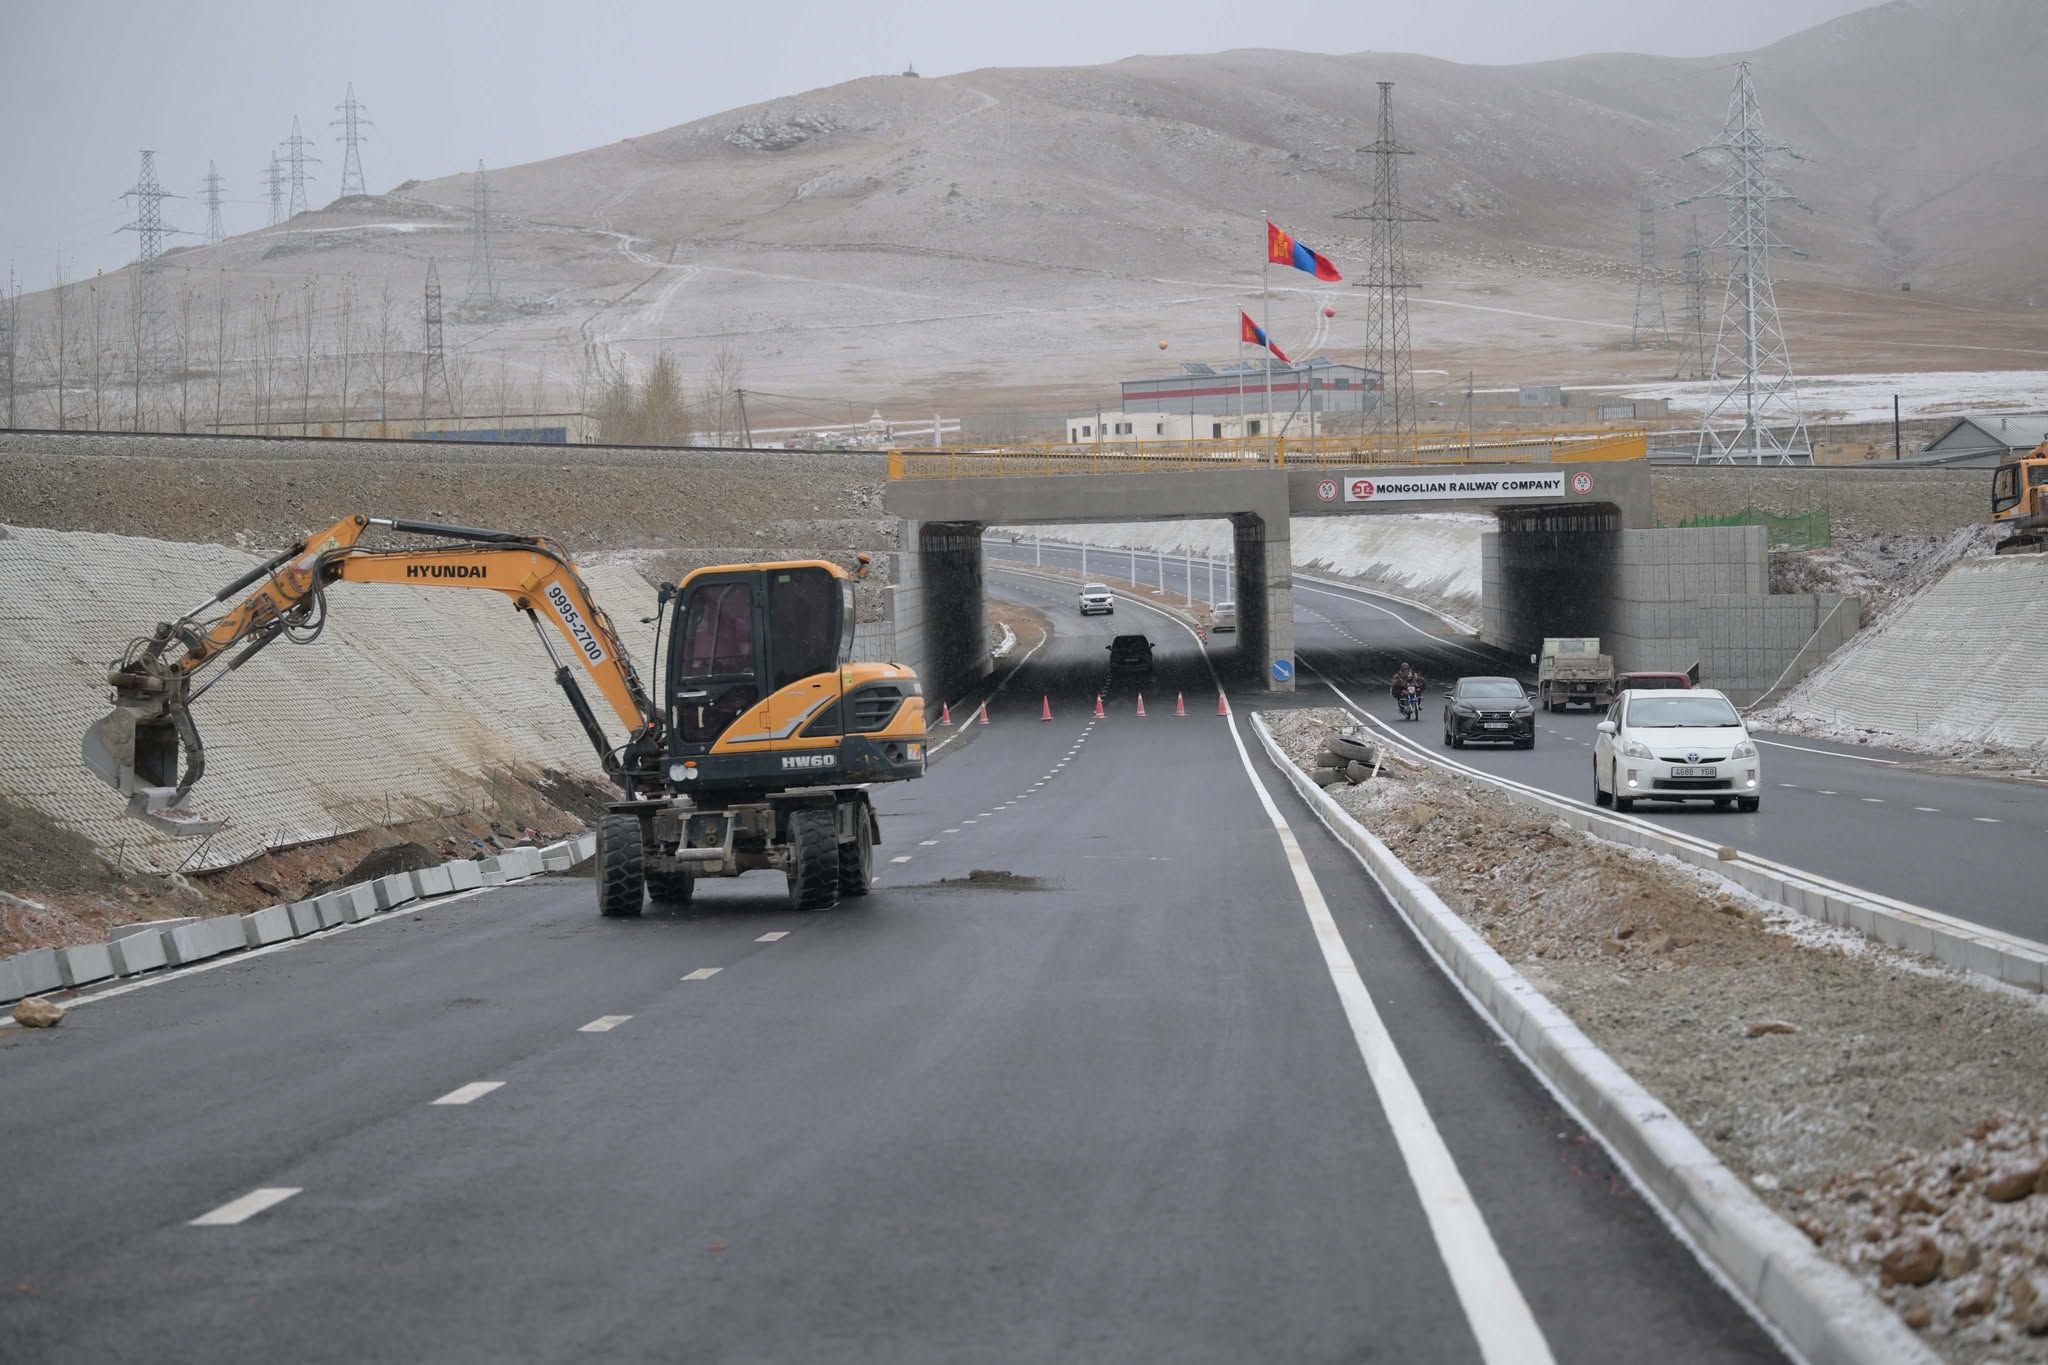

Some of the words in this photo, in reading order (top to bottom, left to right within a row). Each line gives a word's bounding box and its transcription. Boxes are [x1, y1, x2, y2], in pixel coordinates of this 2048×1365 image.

[1376, 483, 1446, 494] MONGOLIAN
[1449, 481, 1499, 492] RAILWAY
[1501, 480, 1561, 490] COMPANY
[406, 565, 487, 579] HYUNDAI
[549, 587, 602, 661] 9995-2700
[782, 754, 835, 768] HW60
